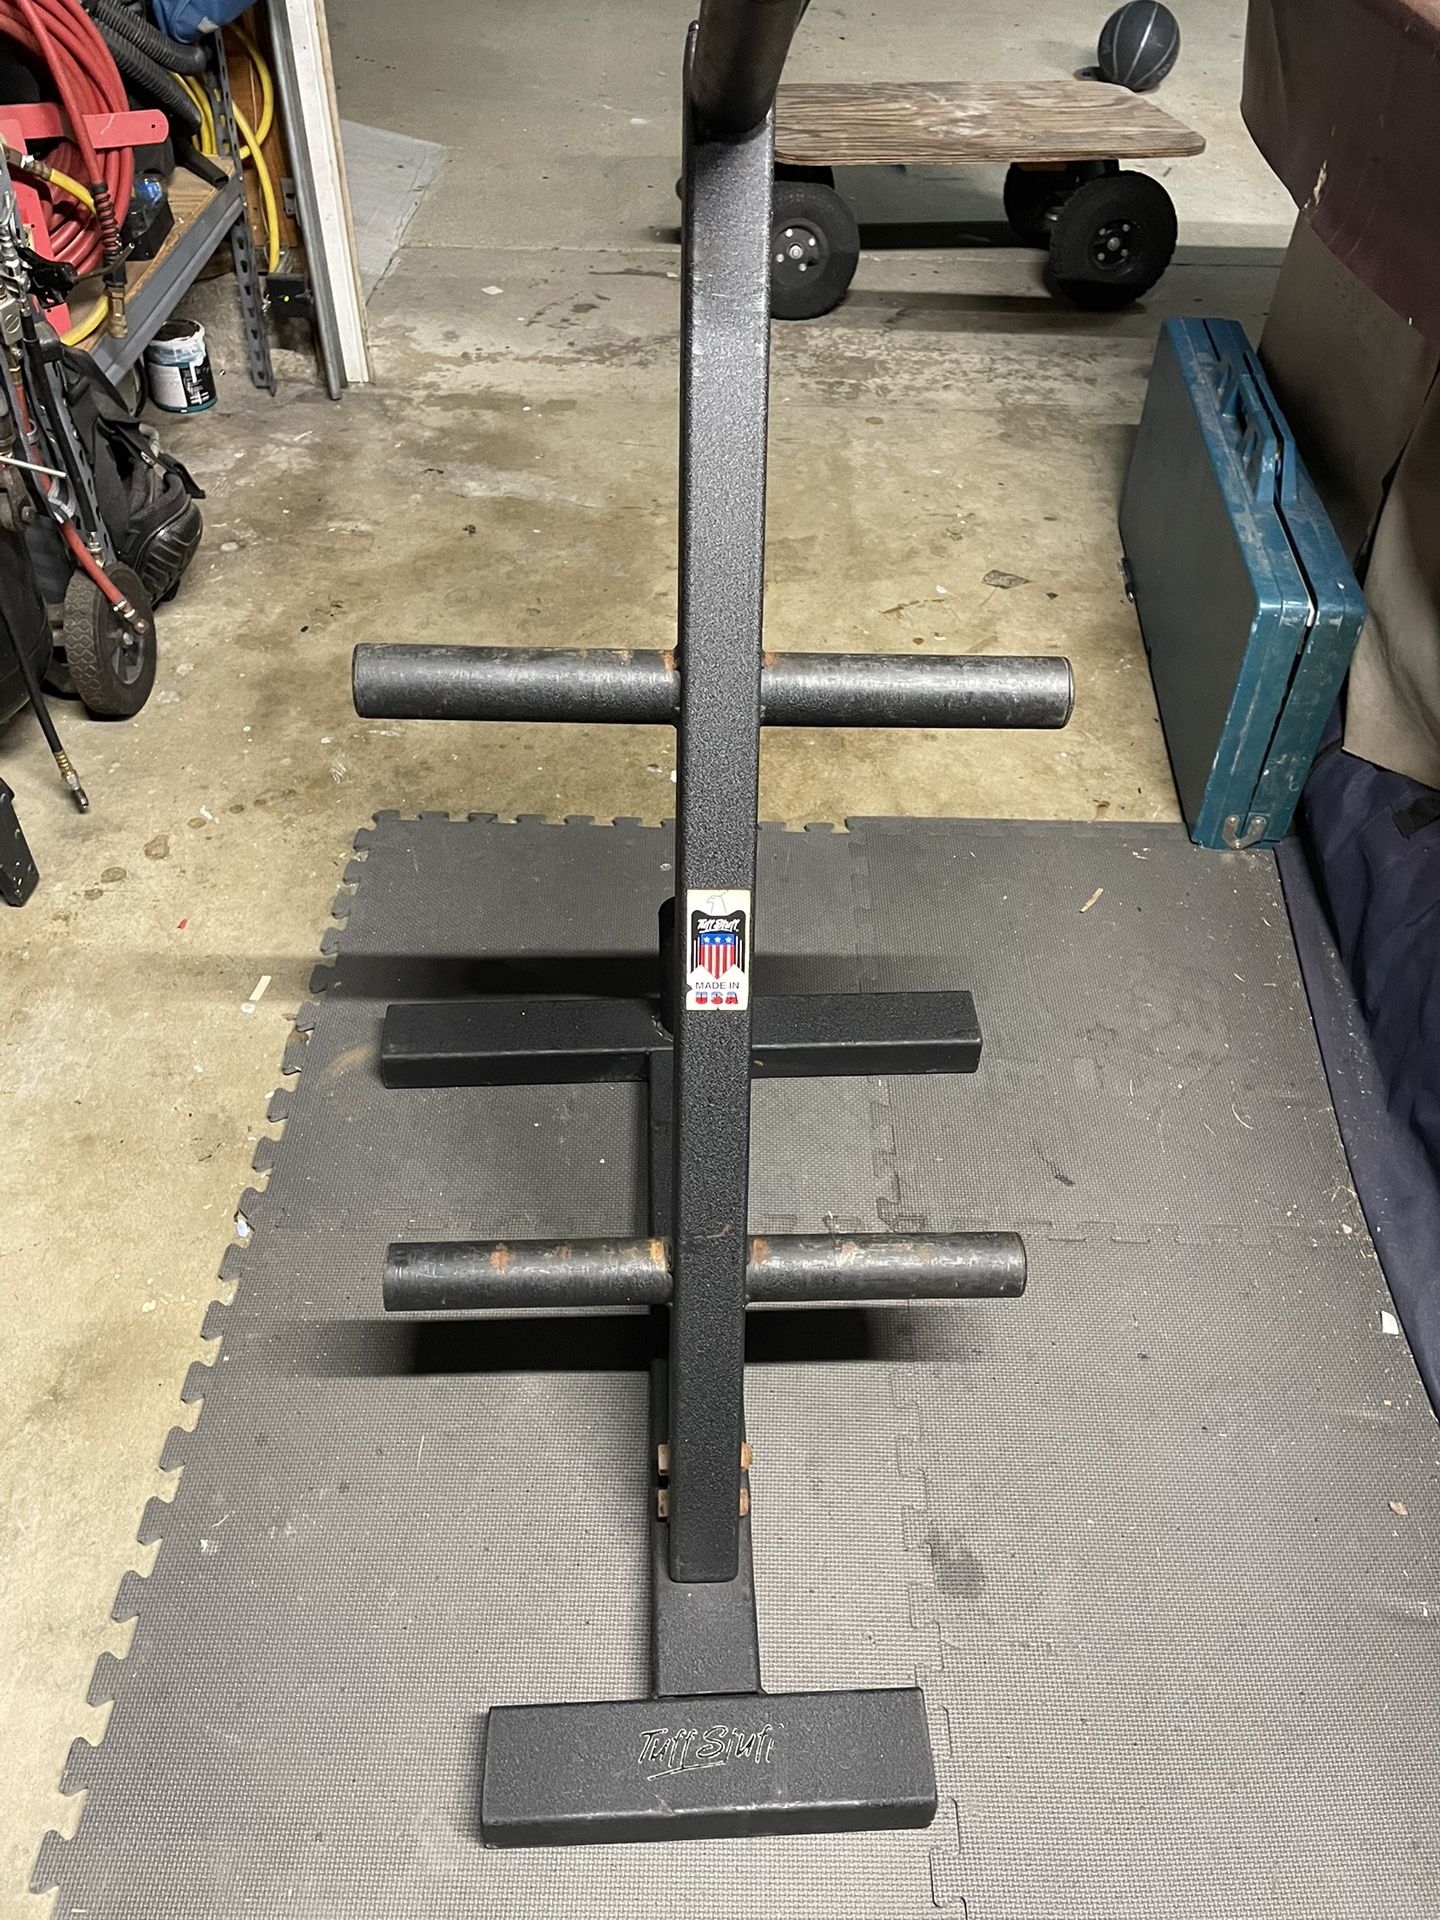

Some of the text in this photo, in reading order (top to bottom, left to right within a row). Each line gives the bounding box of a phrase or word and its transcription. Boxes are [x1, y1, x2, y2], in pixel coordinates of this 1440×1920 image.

[695, 981, 740, 990] MADE IN
[695, 991, 739, 1005] USA
[638, 1728, 698, 1768] Tuff
